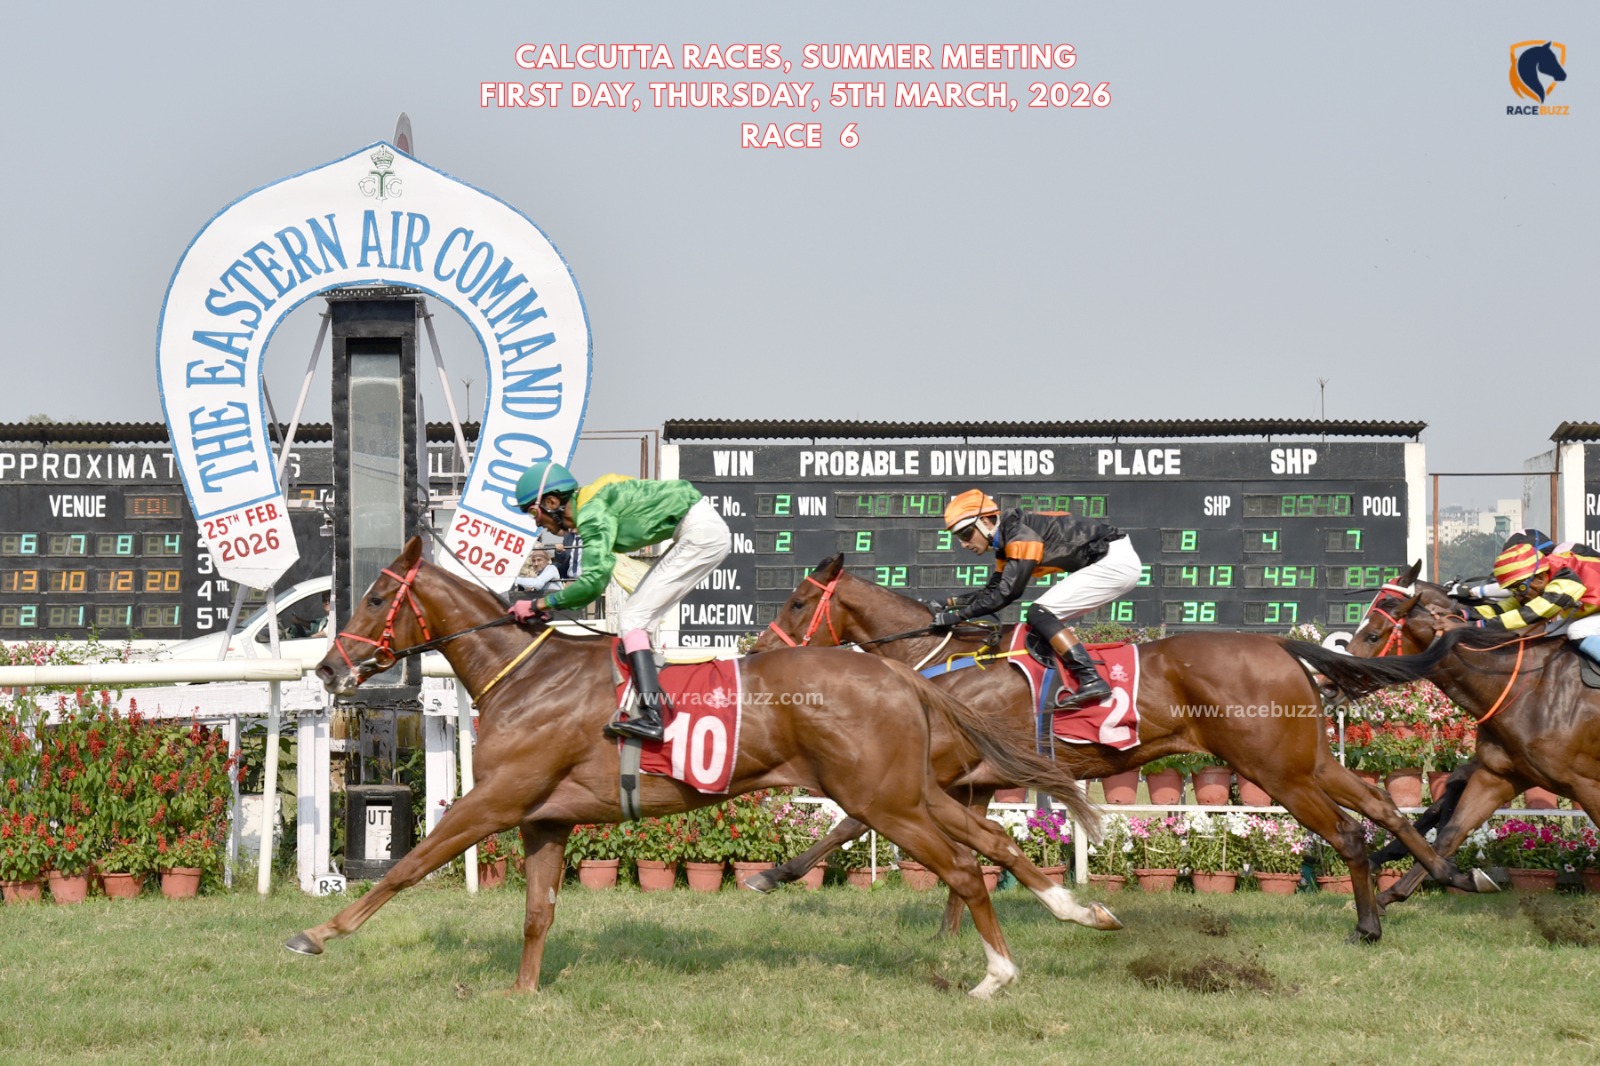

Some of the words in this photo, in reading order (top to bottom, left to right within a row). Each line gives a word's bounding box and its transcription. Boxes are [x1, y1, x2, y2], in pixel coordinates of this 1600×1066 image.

[356, 209, 431, 273] AIR
[186, 213, 348, 389] EASTERN
[433, 226, 563, 421] COMMAND
[189, 400, 259, 494] THE
[713, 450, 754, 476] WIN
[800, 450, 920, 477] PROBABLE
[931, 449, 1055, 476] DIVIDENDS
[1097, 449, 1181, 475] PLACE
[1270, 448, 1318, 474] SHP
[49, 494, 106, 517] VENUE
[134, 498, 174, 514] CAL
[723, 495, 746, 516] No.
[775, 495, 791, 515] 2
[798, 496, 827, 516] WIN
[1204, 495, 1231, 516] SHP
[1362, 496, 1401, 517] POOL
[203, 513, 240, 540] 25TH
[245, 503, 283, 527] FEB.
[21, 534, 37, 554] 6
[70, 534, 86, 555] 7
[116, 534, 133, 555] 8
[164, 534, 180, 554] 4
[218, 528, 280, 562] 2026
[455, 514, 497, 538] 25TH
[494, 529, 525, 558] FEB.
[775, 531, 791, 551] 2
[855, 531, 872, 551] 6
[937, 530, 952, 550] 3
[1181, 530, 1197, 551] 8
[1262, 531, 1278, 551] 4
[1346, 530, 1361, 550] 7
[455, 540, 510, 576] 2026
[12, 570, 38, 591] 13
[61, 570, 86, 591] 10
[109, 570, 133, 591] 12
[146, 571, 180, 591] 20
[713, 569, 741, 590] DIV.
[875, 566, 907, 586] 32
[956, 565, 988, 586] 42
[1264, 566, 1316, 588] 454
[20, 605, 36, 626] 2
[681, 604, 725, 625] PLACE
[727, 604, 754, 625] DIV.
[1110, 601, 1134, 622] 16
[1182, 602, 1216, 622] 36
[1099, 686, 1131, 743] 2
[663, 711, 728, 784] 10
